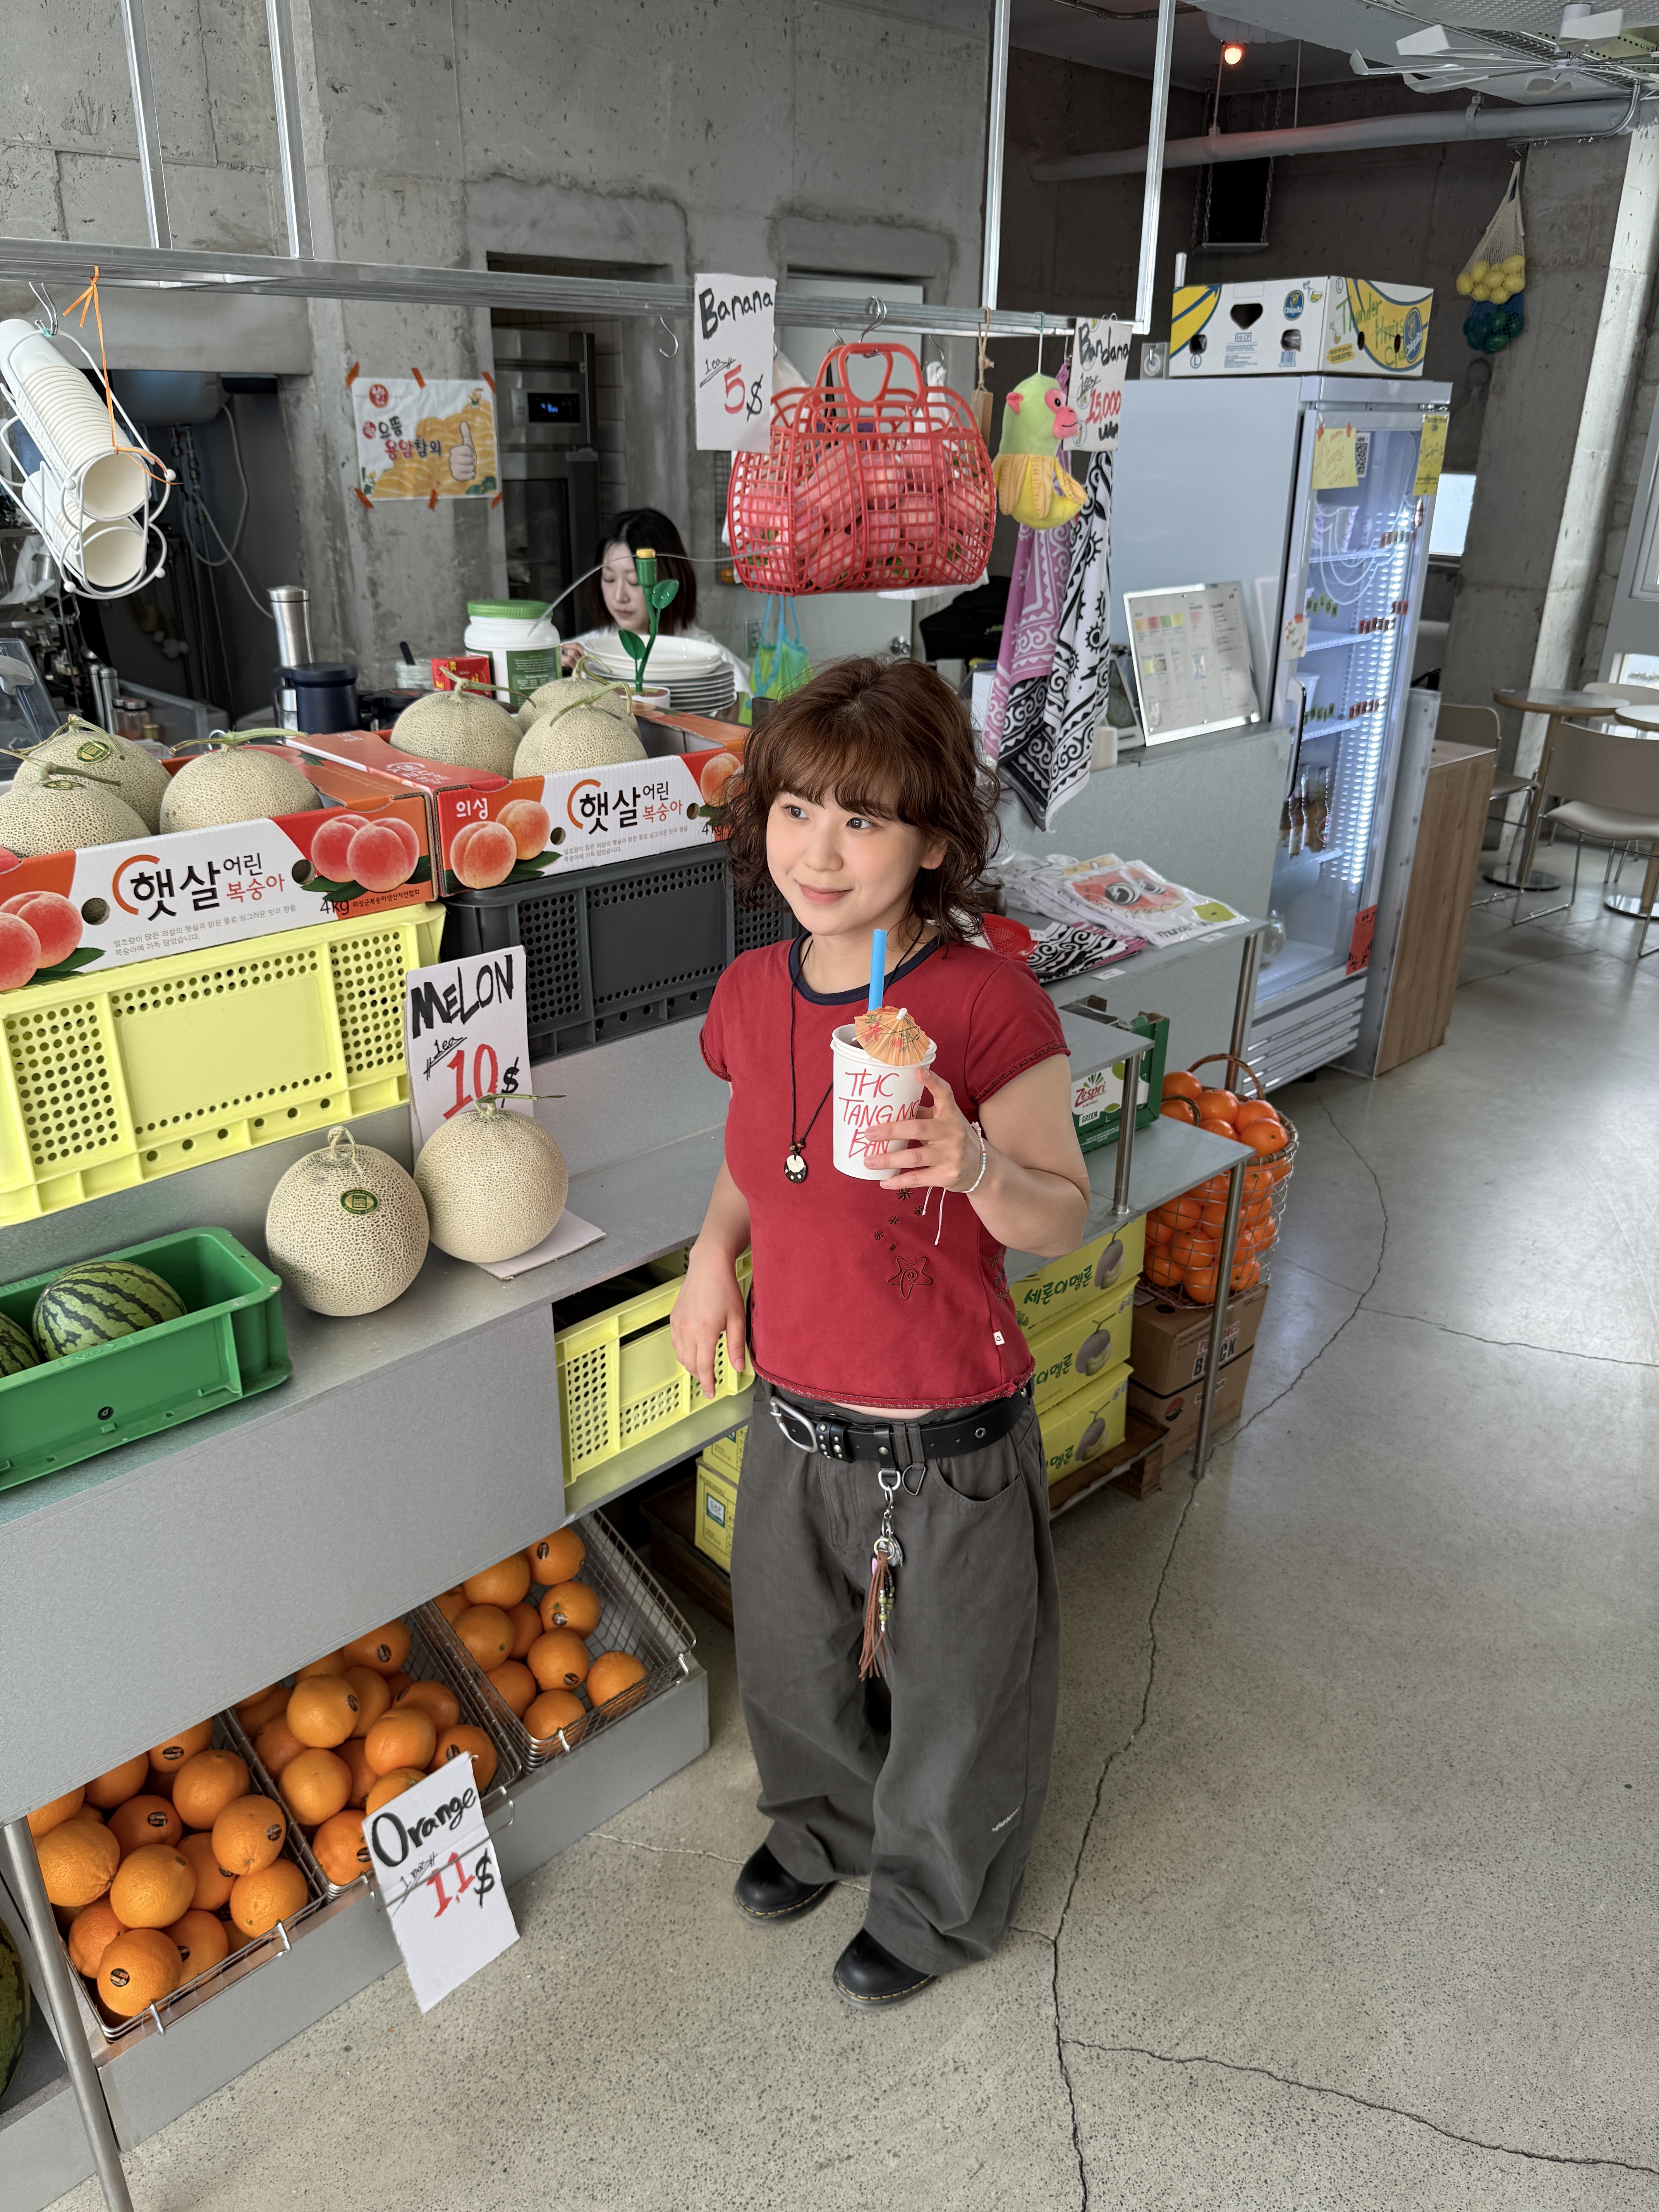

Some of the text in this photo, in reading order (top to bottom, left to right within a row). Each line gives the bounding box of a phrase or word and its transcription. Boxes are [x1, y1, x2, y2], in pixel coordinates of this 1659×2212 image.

[699, 288, 773, 340] Banana
[1336, 293, 1382, 334] Thunder
[1085, 388, 1121, 425] 15,000
[455, 797, 488, 820] 의성
[579, 781, 669, 835] 햇살 어린
[642, 799, 683, 823] 복숭아
[130, 852, 263, 922] 햇살 어린
[226, 873, 285, 903] 복숭아
[320, 898, 350, 915] 4kg
[113, 904, 296, 948] 일조량이 많은 의성의 햇살과 맑은 물로 싱그러운 맛과 향을
[115, 933, 201, 956] 복숭아에 가득 담았습니다.
[411, 954, 514, 1039] MELON
[845, 1068, 900, 1098] THC
[1074, 1081, 1106, 1108] Zespri
[839, 1097, 892, 1128] TANG
[1082, 1111, 1097, 1123] GREEN
[372, 1787, 477, 1867] Orange
